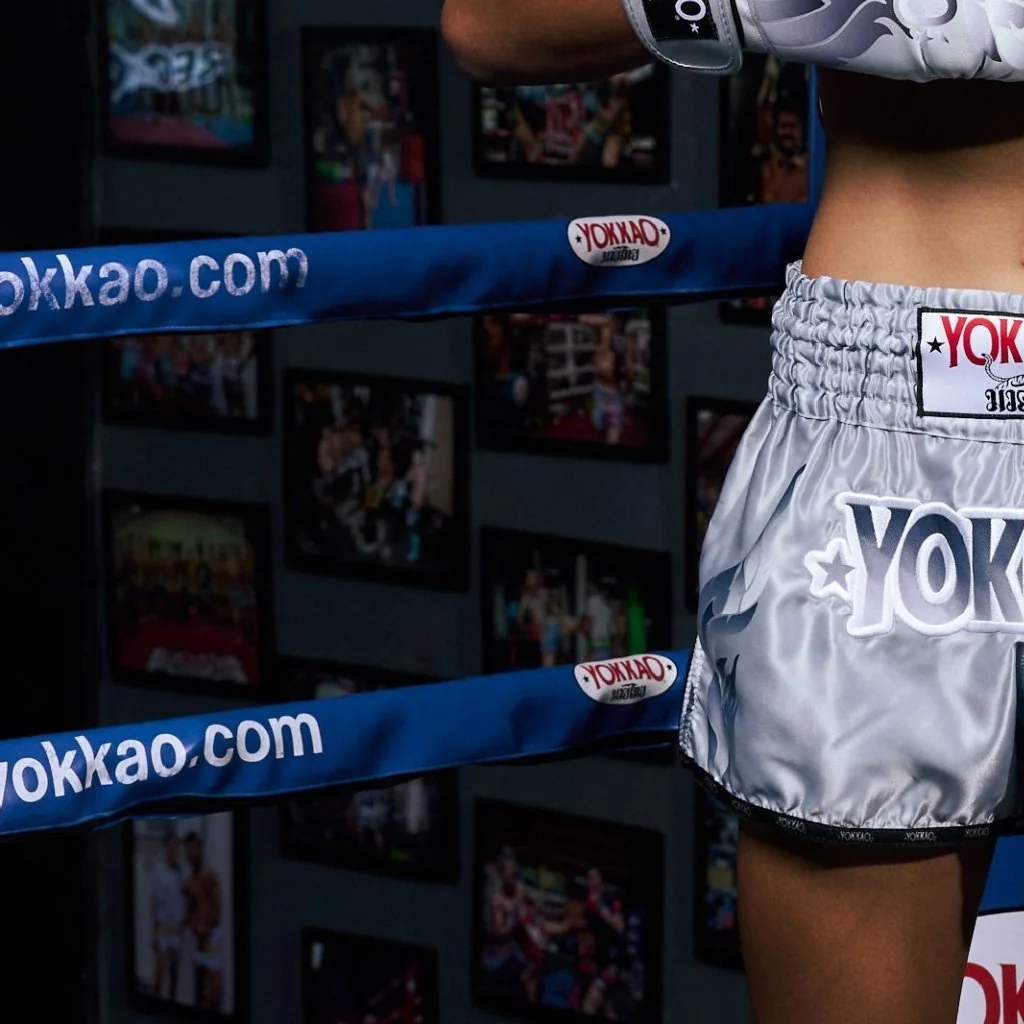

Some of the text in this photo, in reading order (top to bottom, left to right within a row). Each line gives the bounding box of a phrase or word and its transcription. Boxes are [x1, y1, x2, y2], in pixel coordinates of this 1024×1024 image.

[575, 219, 660, 253] YOKKAO
[0, 247, 309, 317] okkao.com
[582, 656, 665, 690] YOKKAO
[0, 713, 323, 808] okkao.com
